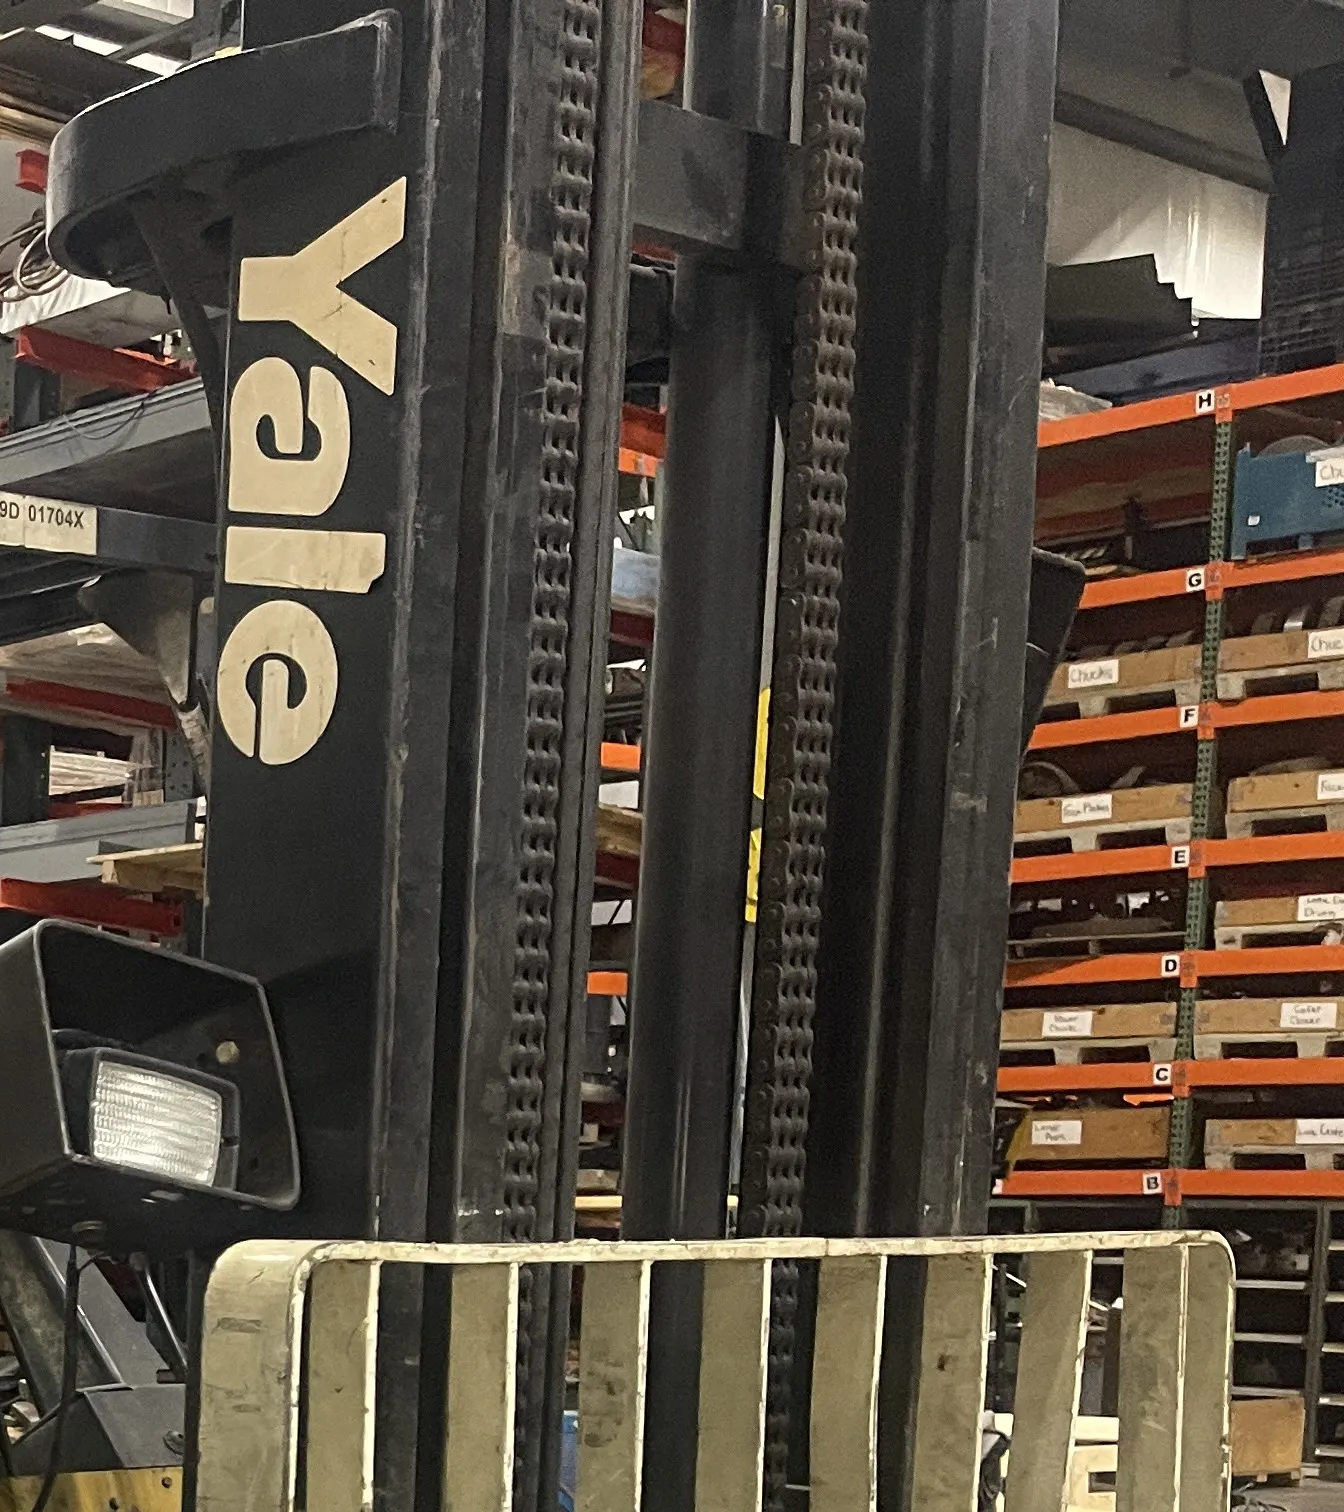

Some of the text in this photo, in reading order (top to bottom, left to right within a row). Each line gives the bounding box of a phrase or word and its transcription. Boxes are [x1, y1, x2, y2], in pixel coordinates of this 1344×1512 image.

[1199, 394, 1212, 409] H
[217, 176, 406, 765] Yale
[28, 504, 85, 530] 01704X
[1189, 573, 1202, 588] G
[1184, 708, 1196, 723] F
[1174, 850, 1187, 864] E
[1165, 960, 1177, 973] D
[1156, 1068, 1169, 1082] C
[1147, 1177, 1160, 1190] B
